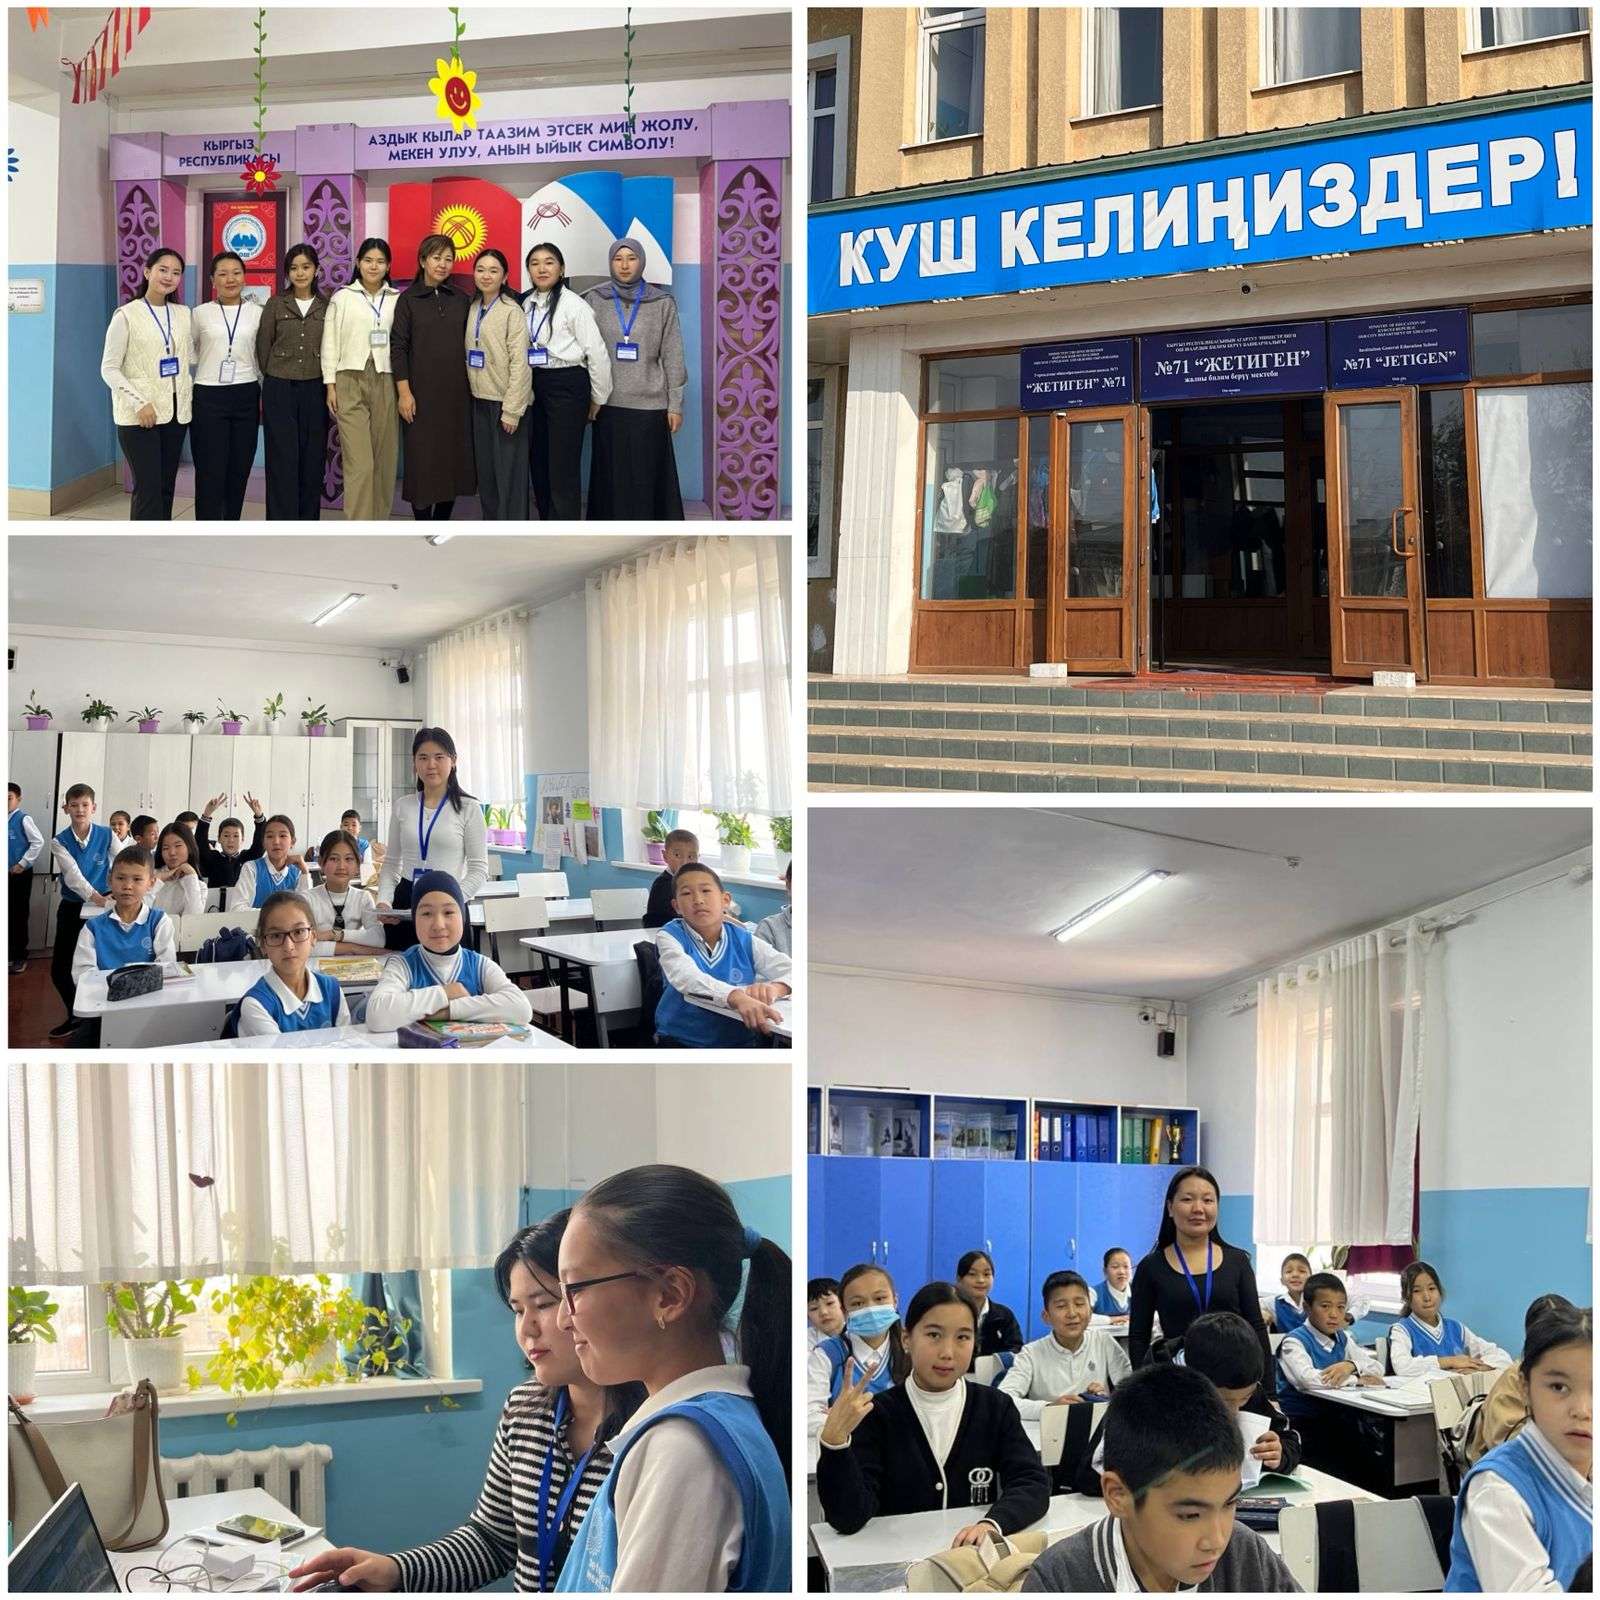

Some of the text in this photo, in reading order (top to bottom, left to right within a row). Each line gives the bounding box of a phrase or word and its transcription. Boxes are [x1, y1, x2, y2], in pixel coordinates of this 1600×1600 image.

[368, 132, 417, 147] АЗДЫК
[422, 129, 472, 143] КЫЛАР
[478, 125, 540, 140] ТААЗИМ
[546, 122, 593, 137] ЭТСЕК
[641, 118, 699, 132] ЖОЛУ,
[203, 139, 255, 152] КЫРГЫЗ
[388, 136, 674, 161] МЕКЕН УЛУУ, АНЫН ЫЙЫК СИМВОЛУ!
[839, 128, 1579, 287] КУШ КЕЛИҢИЗДЕР!
[1155, 350, 1310, 376] №71 “ЖЕТИГЕН”
[1343, 350, 1457, 371] №71 “JETIGEN”
[1026, 376, 1126, 394] “ЖЕТИГЕН” №71
